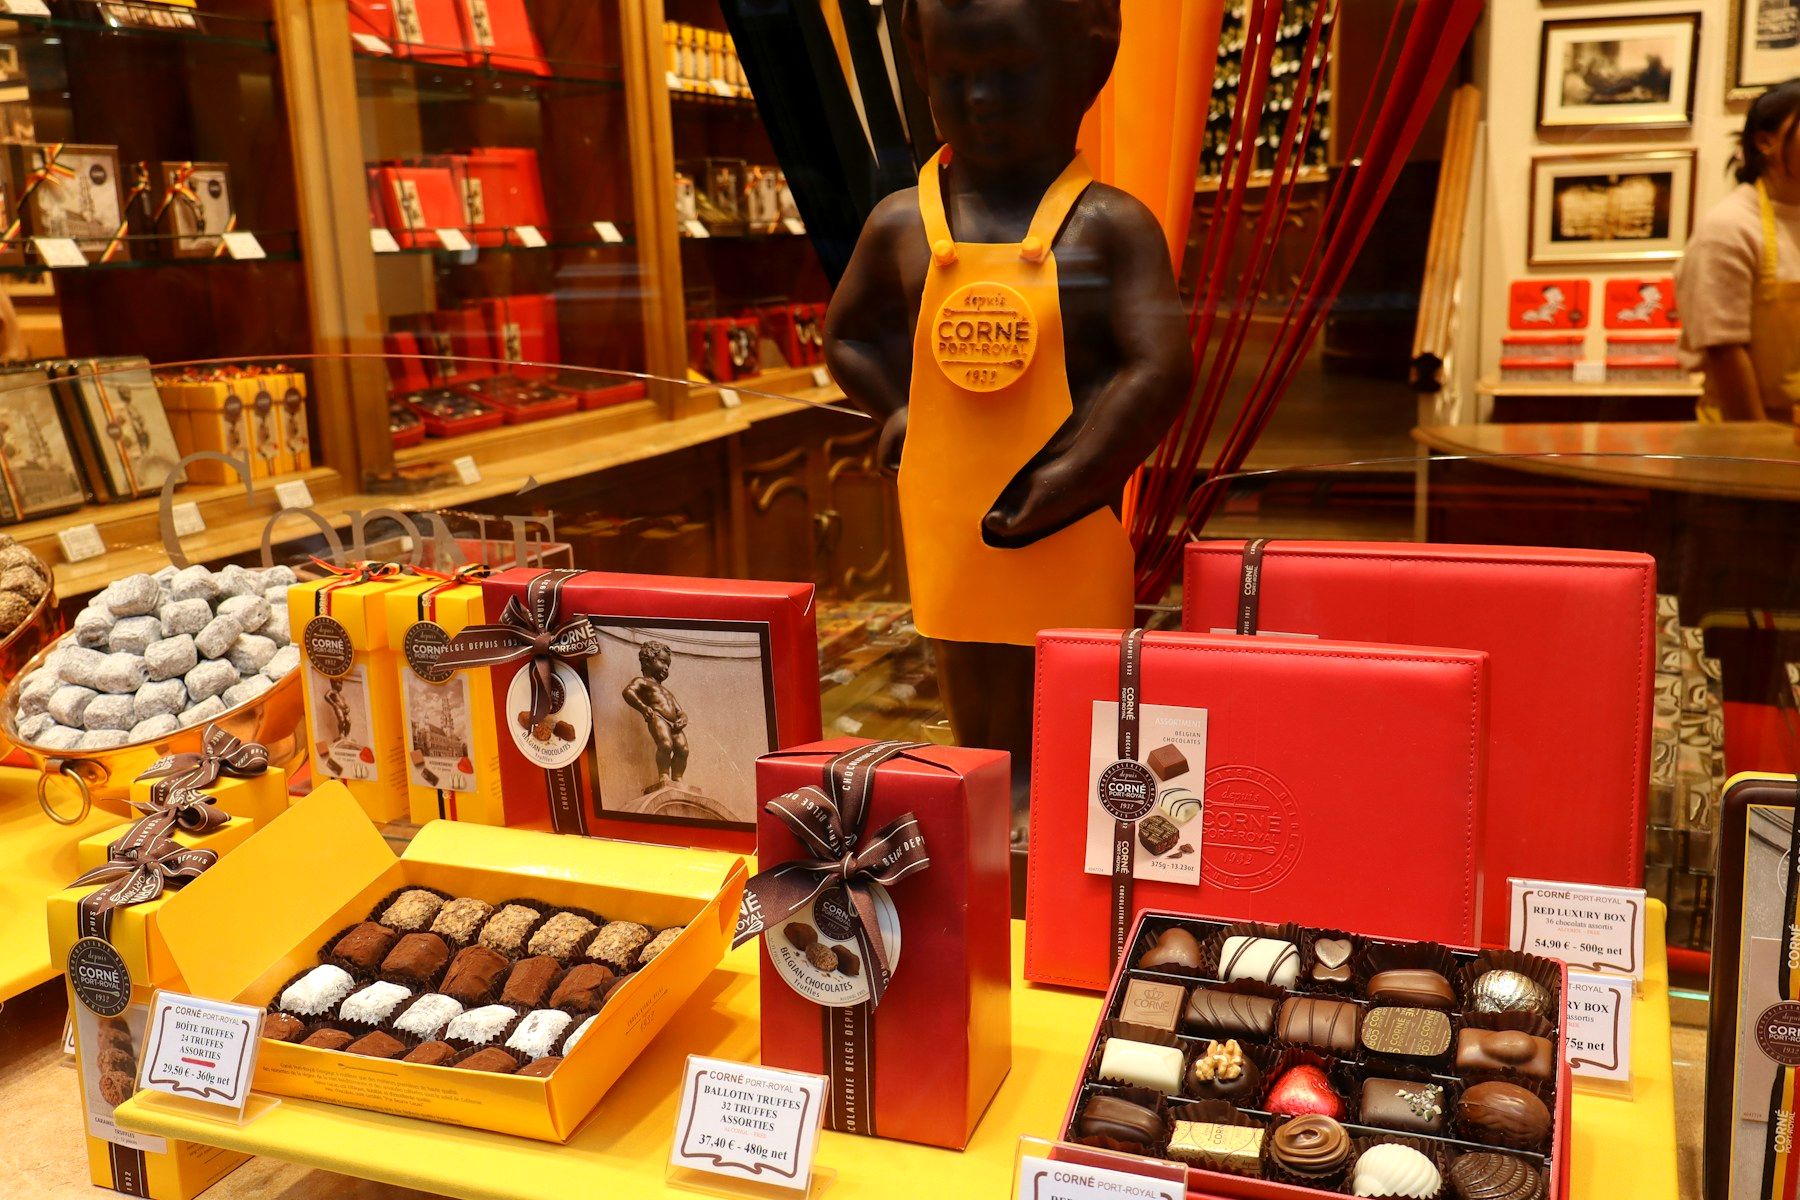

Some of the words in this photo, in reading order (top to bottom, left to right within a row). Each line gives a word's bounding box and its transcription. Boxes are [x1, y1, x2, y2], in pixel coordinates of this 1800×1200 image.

[938, 317, 1030, 342] CORNÉ
[938, 342, 1028, 357] PORT-ROYAL
[1243, 564, 1255, 596] CORNÉ
[537, 598, 546, 632] DEPUIS
[311, 638, 345, 650] CORNÉ
[468, 640, 499, 651] DEPUIS
[1126, 686, 1136, 721] CORNÉ
[1154, 717, 1201, 729] ASSORTMENT
[1161, 737, 1201, 746] CHOCOLATES
[1174, 730, 1201, 739] BELGIAN
[1108, 782, 1147, 795] CORNÉ
[1108, 790, 1146, 800] PORT-ROYAL
[1221, 785, 1261, 807] depuis
[1203, 809, 1282, 832] CORNÉ
[1119, 840, 1130, 875] CORNÉ
[1151, 860, 1167, 870] 375g
[1171, 862, 1195, 872] 13.23oz
[1222, 850, 1255, 866] 1932
[1536, 889, 1572, 901] CORNÉ
[1572, 894, 1622, 906] PORT-ROYAL
[1533, 905, 1556, 916] RED
[1557, 909, 1602, 921] LUXURY
[1603, 914, 1627, 924] BOX
[1546, 917, 1554, 925] 36
[1555, 919, 1587, 929] chocolats
[1587, 923, 1613, 931] assortis
[1562, 941, 1571, 951] €
[1579, 942, 1604, 956] 500g
[1606, 946, 1623, 957] net
[78, 965, 120, 984] CORNÉ
[780, 946, 804, 980] BELGIAN
[804, 975, 854, 994] CHOCOLATES
[80, 976, 121, 991] PORT-ROYAL
[793, 977, 821, 998] Truffles
[175, 1006, 202, 1019] CORNÉ
[202, 1012, 240, 1026] PORT-ROYAL
[1584, 1003, 1610, 1015] BOX
[175, 1021, 199, 1033] BOÎTE
[200, 1025, 235, 1040] TRUFFES
[181, 1034, 189, 1042] 24
[190, 1036, 225, 1050] TRUFFES
[1587, 1040, 1606, 1052] net
[179, 1046, 222, 1061] ASSORTIES
[844, 1040, 855, 1073] BELGE
[162, 1063, 183, 1077] 29,50
[184, 1069, 191, 1078] €
[195, 1070, 216, 1085] 360g
[217, 1077, 231, 1086] net
[709, 1069, 744, 1085] CORNÉ
[745, 1078, 794, 1094] PORT-ROYAL
[703, 1085, 755, 1101] BALLOTIN
[756, 1094, 802, 1111] TRUFFES
[721, 1101, 732, 1111] 32
[733, 1104, 779, 1119] TRUFFES
[719, 1115, 776, 1132] ASSORTIES
[1773, 1109, 1789, 1154] CORNÉ
[1784, 1111, 1796, 1154] PORT-ROYAL
[698, 1134, 727, 1149] 37,40
[727, 1139, 735, 1151] €
[743, 1142, 769, 1159] 480g
[770, 1149, 788, 1161] net
[124, 1171, 133, 1192] 1932
[1053, 1171, 1096, 1188] CORNÉ
[1096, 1180, 1157, 1199] PORT-ROYAL
